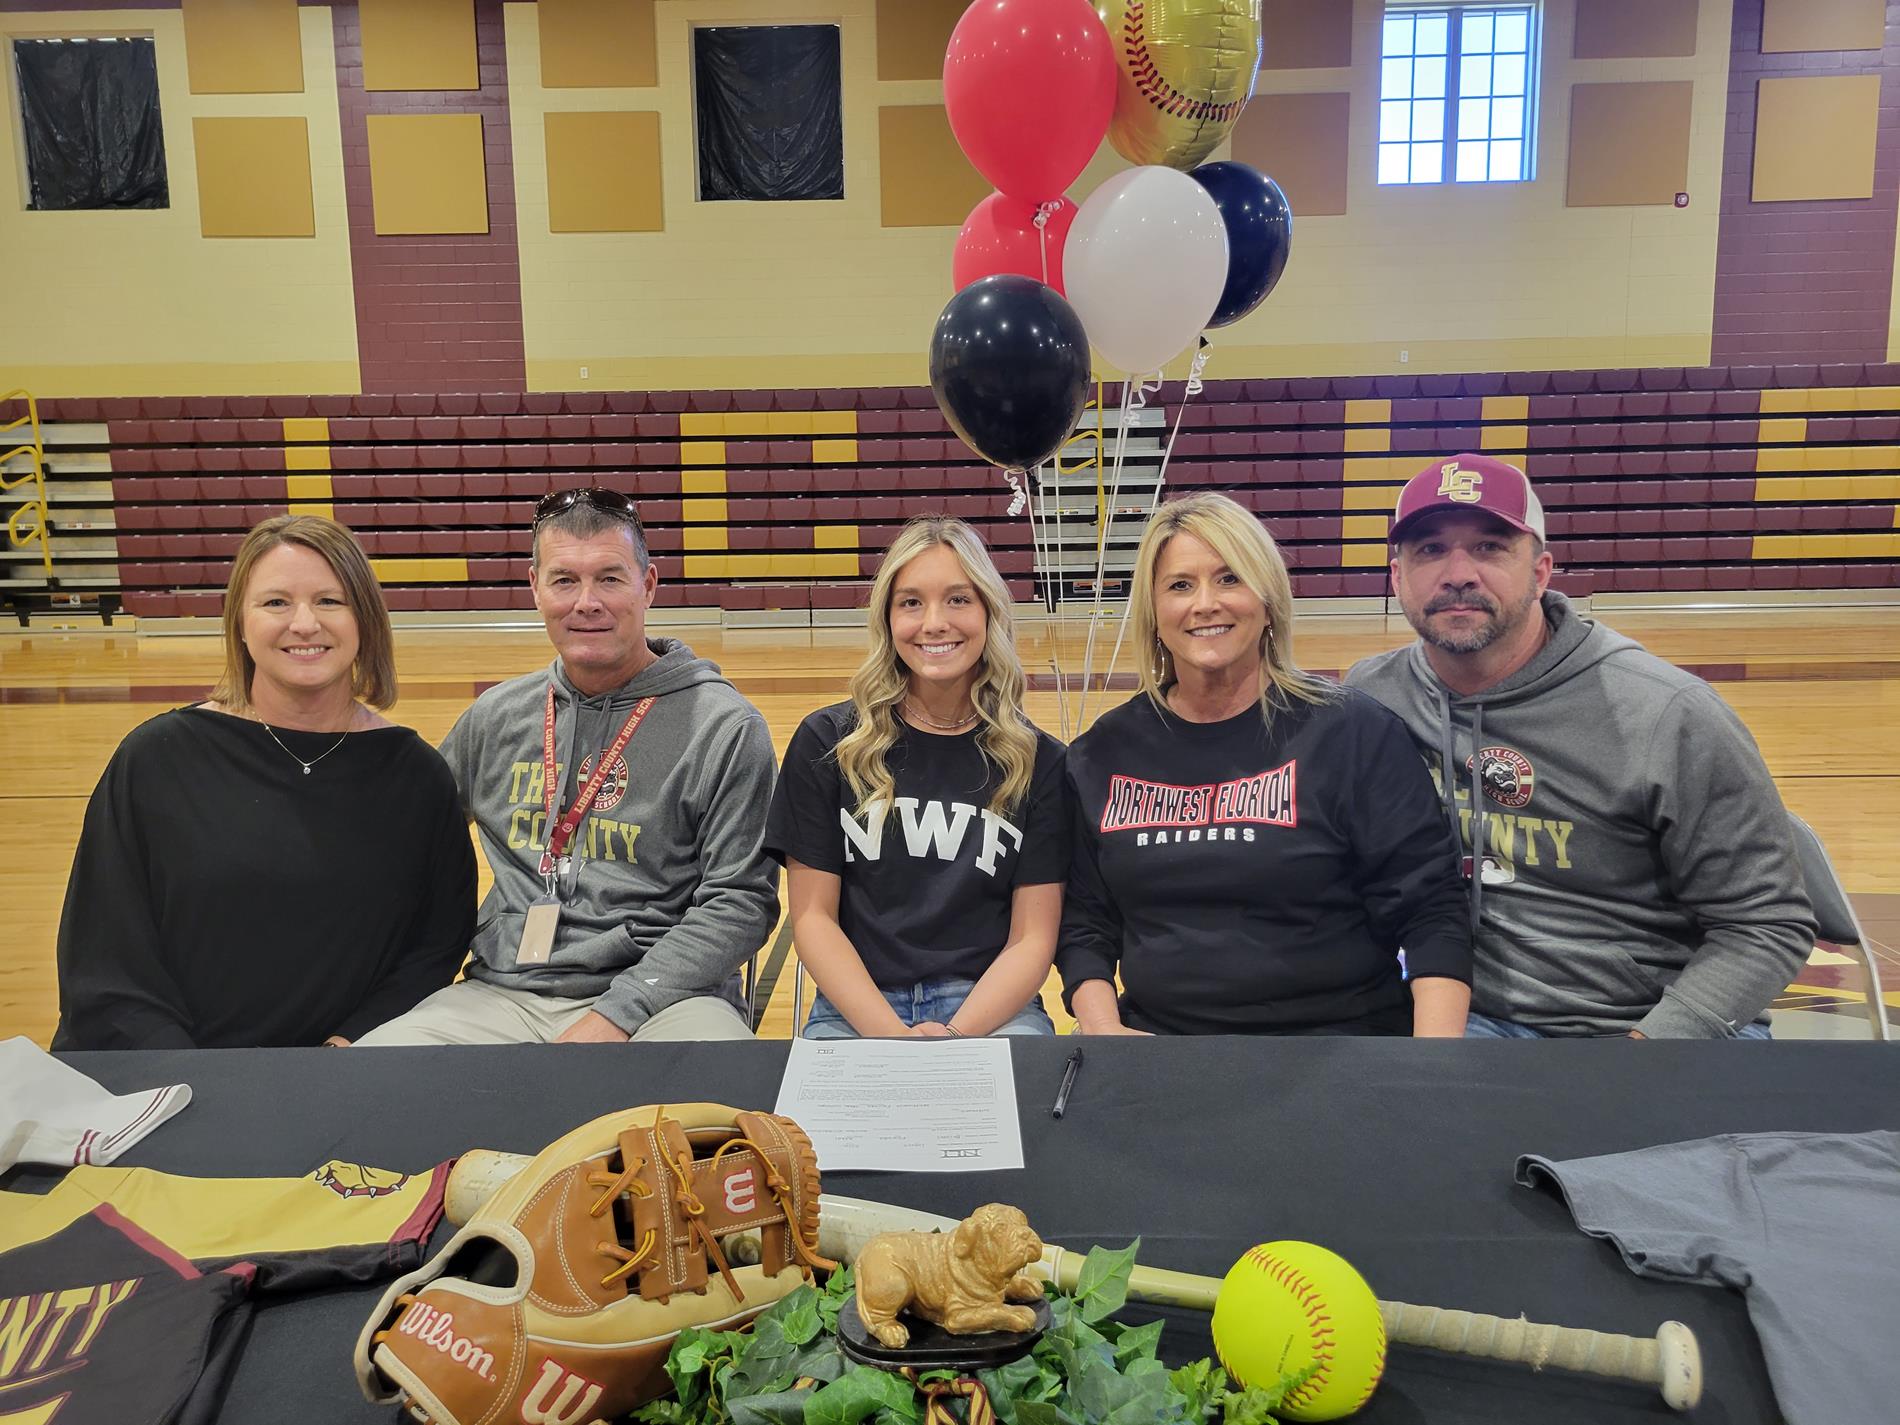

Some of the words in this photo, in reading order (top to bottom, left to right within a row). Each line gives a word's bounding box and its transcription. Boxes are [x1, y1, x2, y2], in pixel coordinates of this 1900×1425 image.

[1437, 462, 1483, 503] LC
[545, 728, 554, 765] COUNTY
[574, 773, 603, 814] LIBERTY
[599, 737, 626, 773] COUNTY
[621, 715, 640, 738] HIGH
[1503, 750, 1529, 772] COUNTY
[546, 768, 555, 791] HIGH
[594, 793, 620, 809] SCHOOL
[1103, 776, 1212, 828] NORTHWEST
[1216, 766, 1294, 825] FLORIDA
[507, 809, 641, 864] CONTY
[840, 796, 1022, 877] NWF
[1137, 828, 1255, 847] RAIDERS
[724, 1168, 756, 1213] W
[0, 1278, 143, 1378] NTY
[399, 1301, 495, 1379] Wilson
[520, 1358, 604, 1425] W
